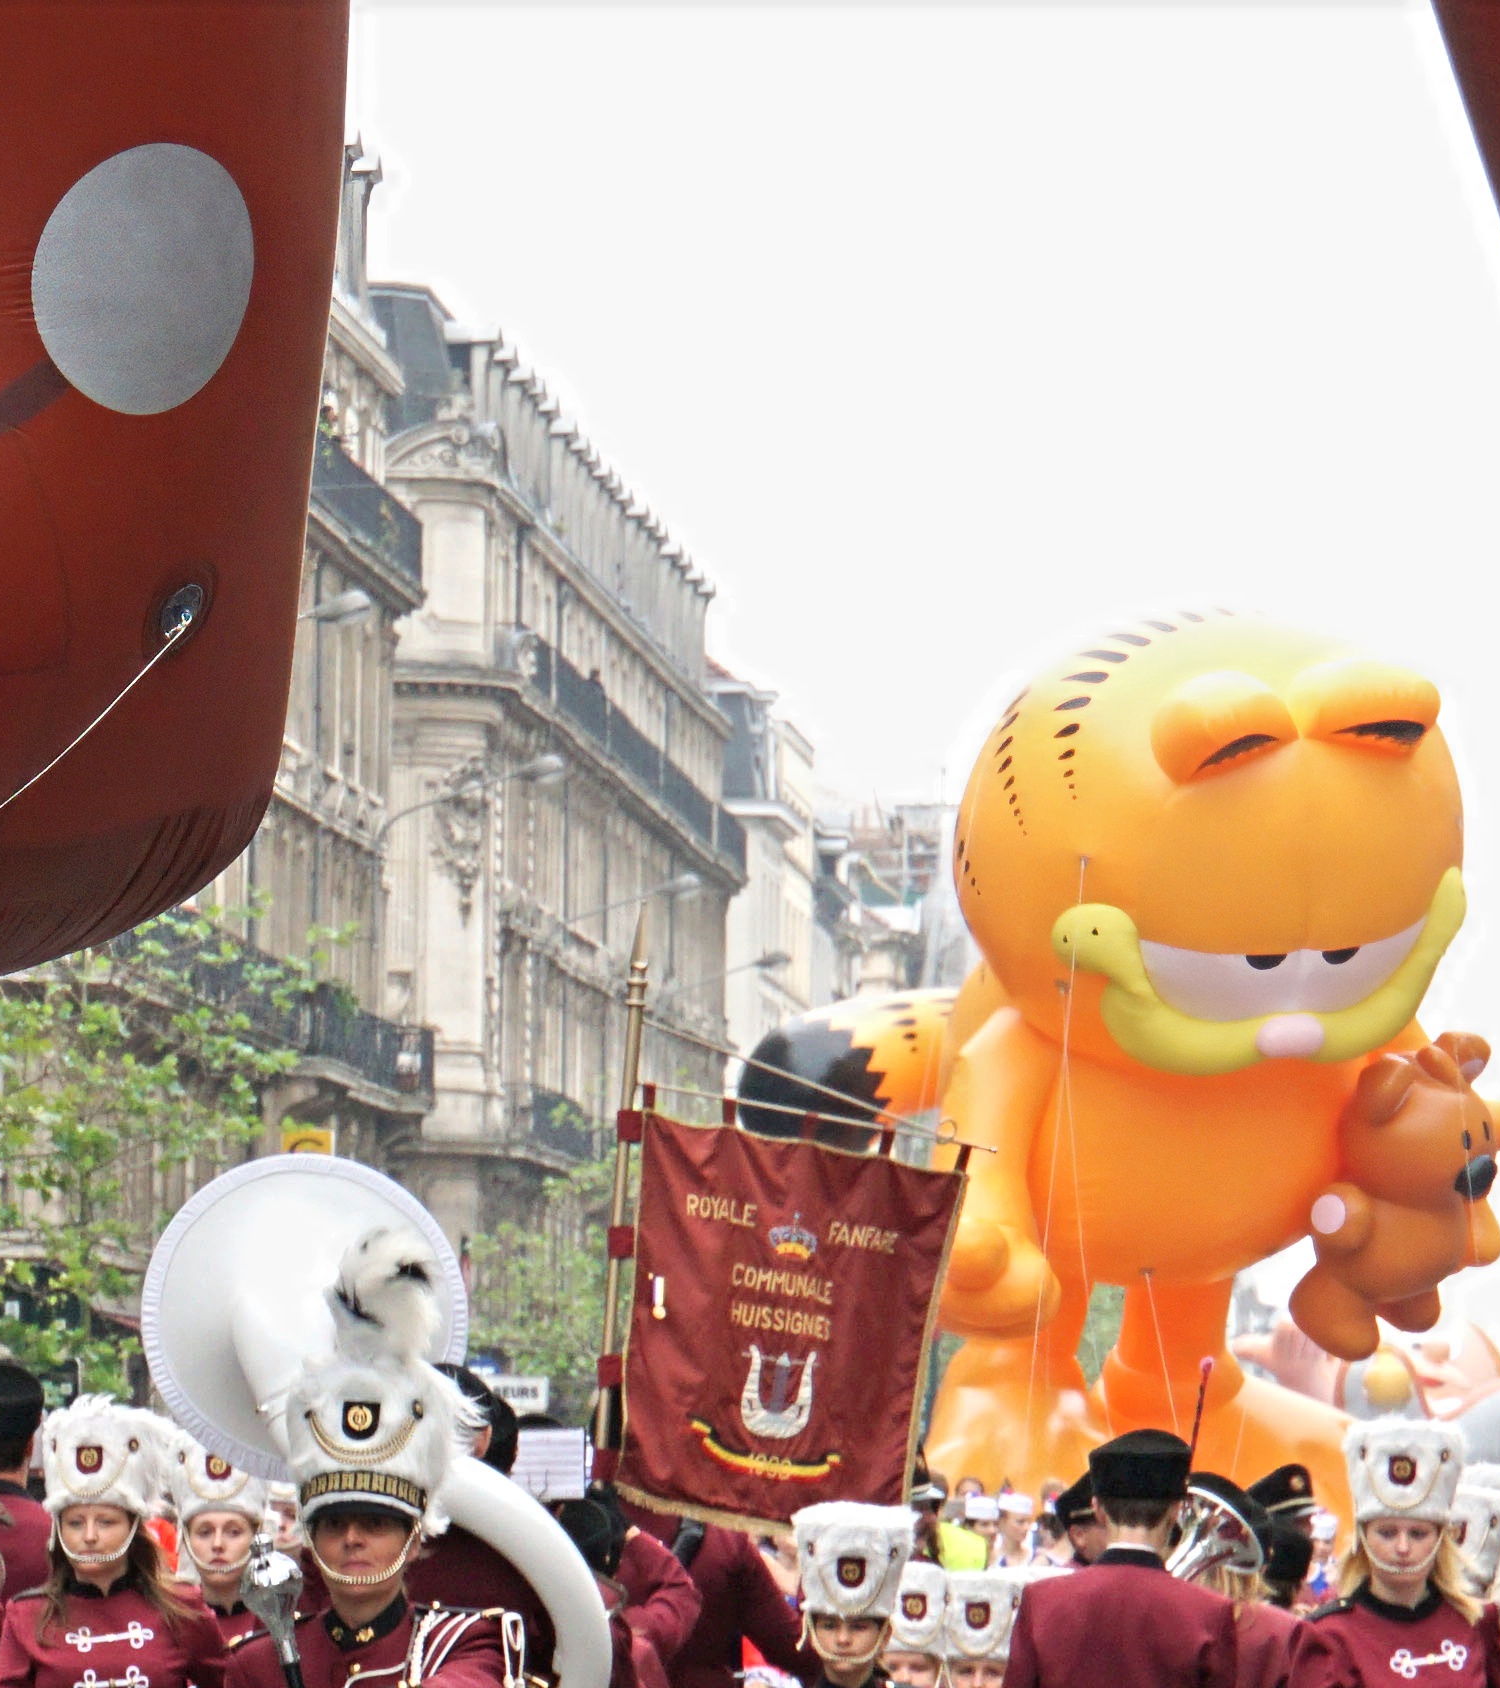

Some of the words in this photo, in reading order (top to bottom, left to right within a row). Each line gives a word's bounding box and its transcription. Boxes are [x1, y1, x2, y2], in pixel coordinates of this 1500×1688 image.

[686, 1193, 758, 1228] ROYALE
[827, 1220, 900, 1254] FANFARE
[731, 1262, 834, 1305] COMMUNALE
[730, 1300, 832, 1342] HUISSIGNES
